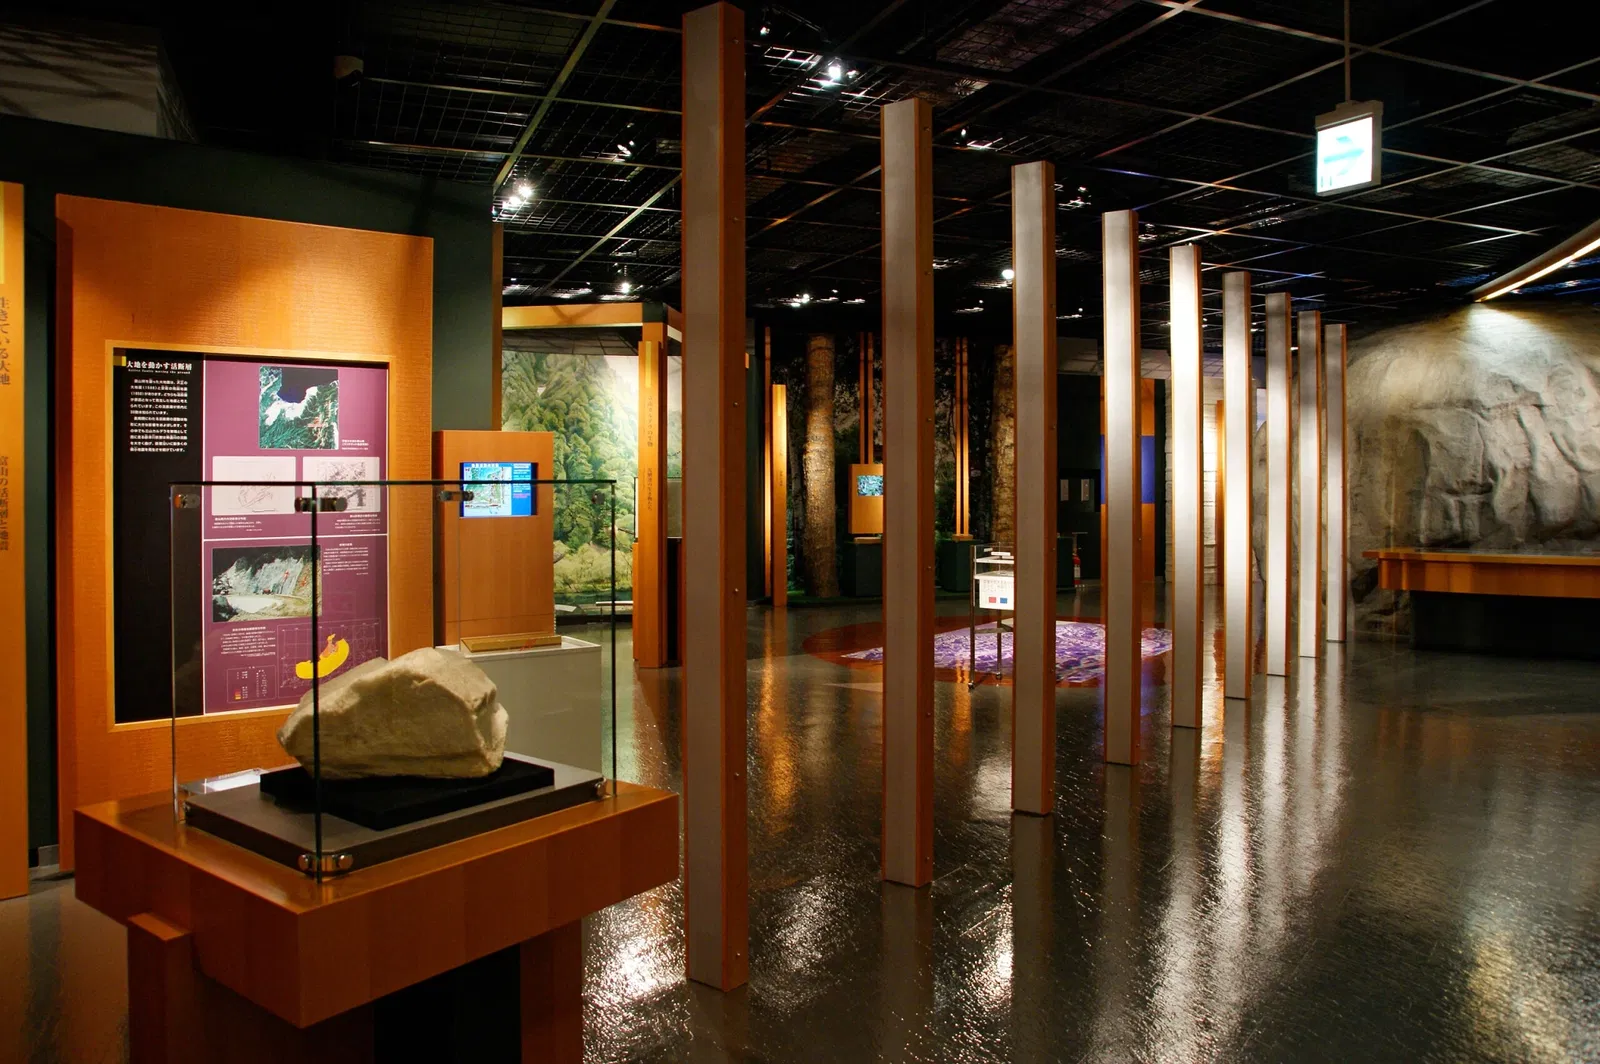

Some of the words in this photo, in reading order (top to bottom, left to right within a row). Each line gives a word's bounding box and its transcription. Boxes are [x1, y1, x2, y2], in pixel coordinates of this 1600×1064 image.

[127, 360, 193, 371] 大地を動かす活断層
